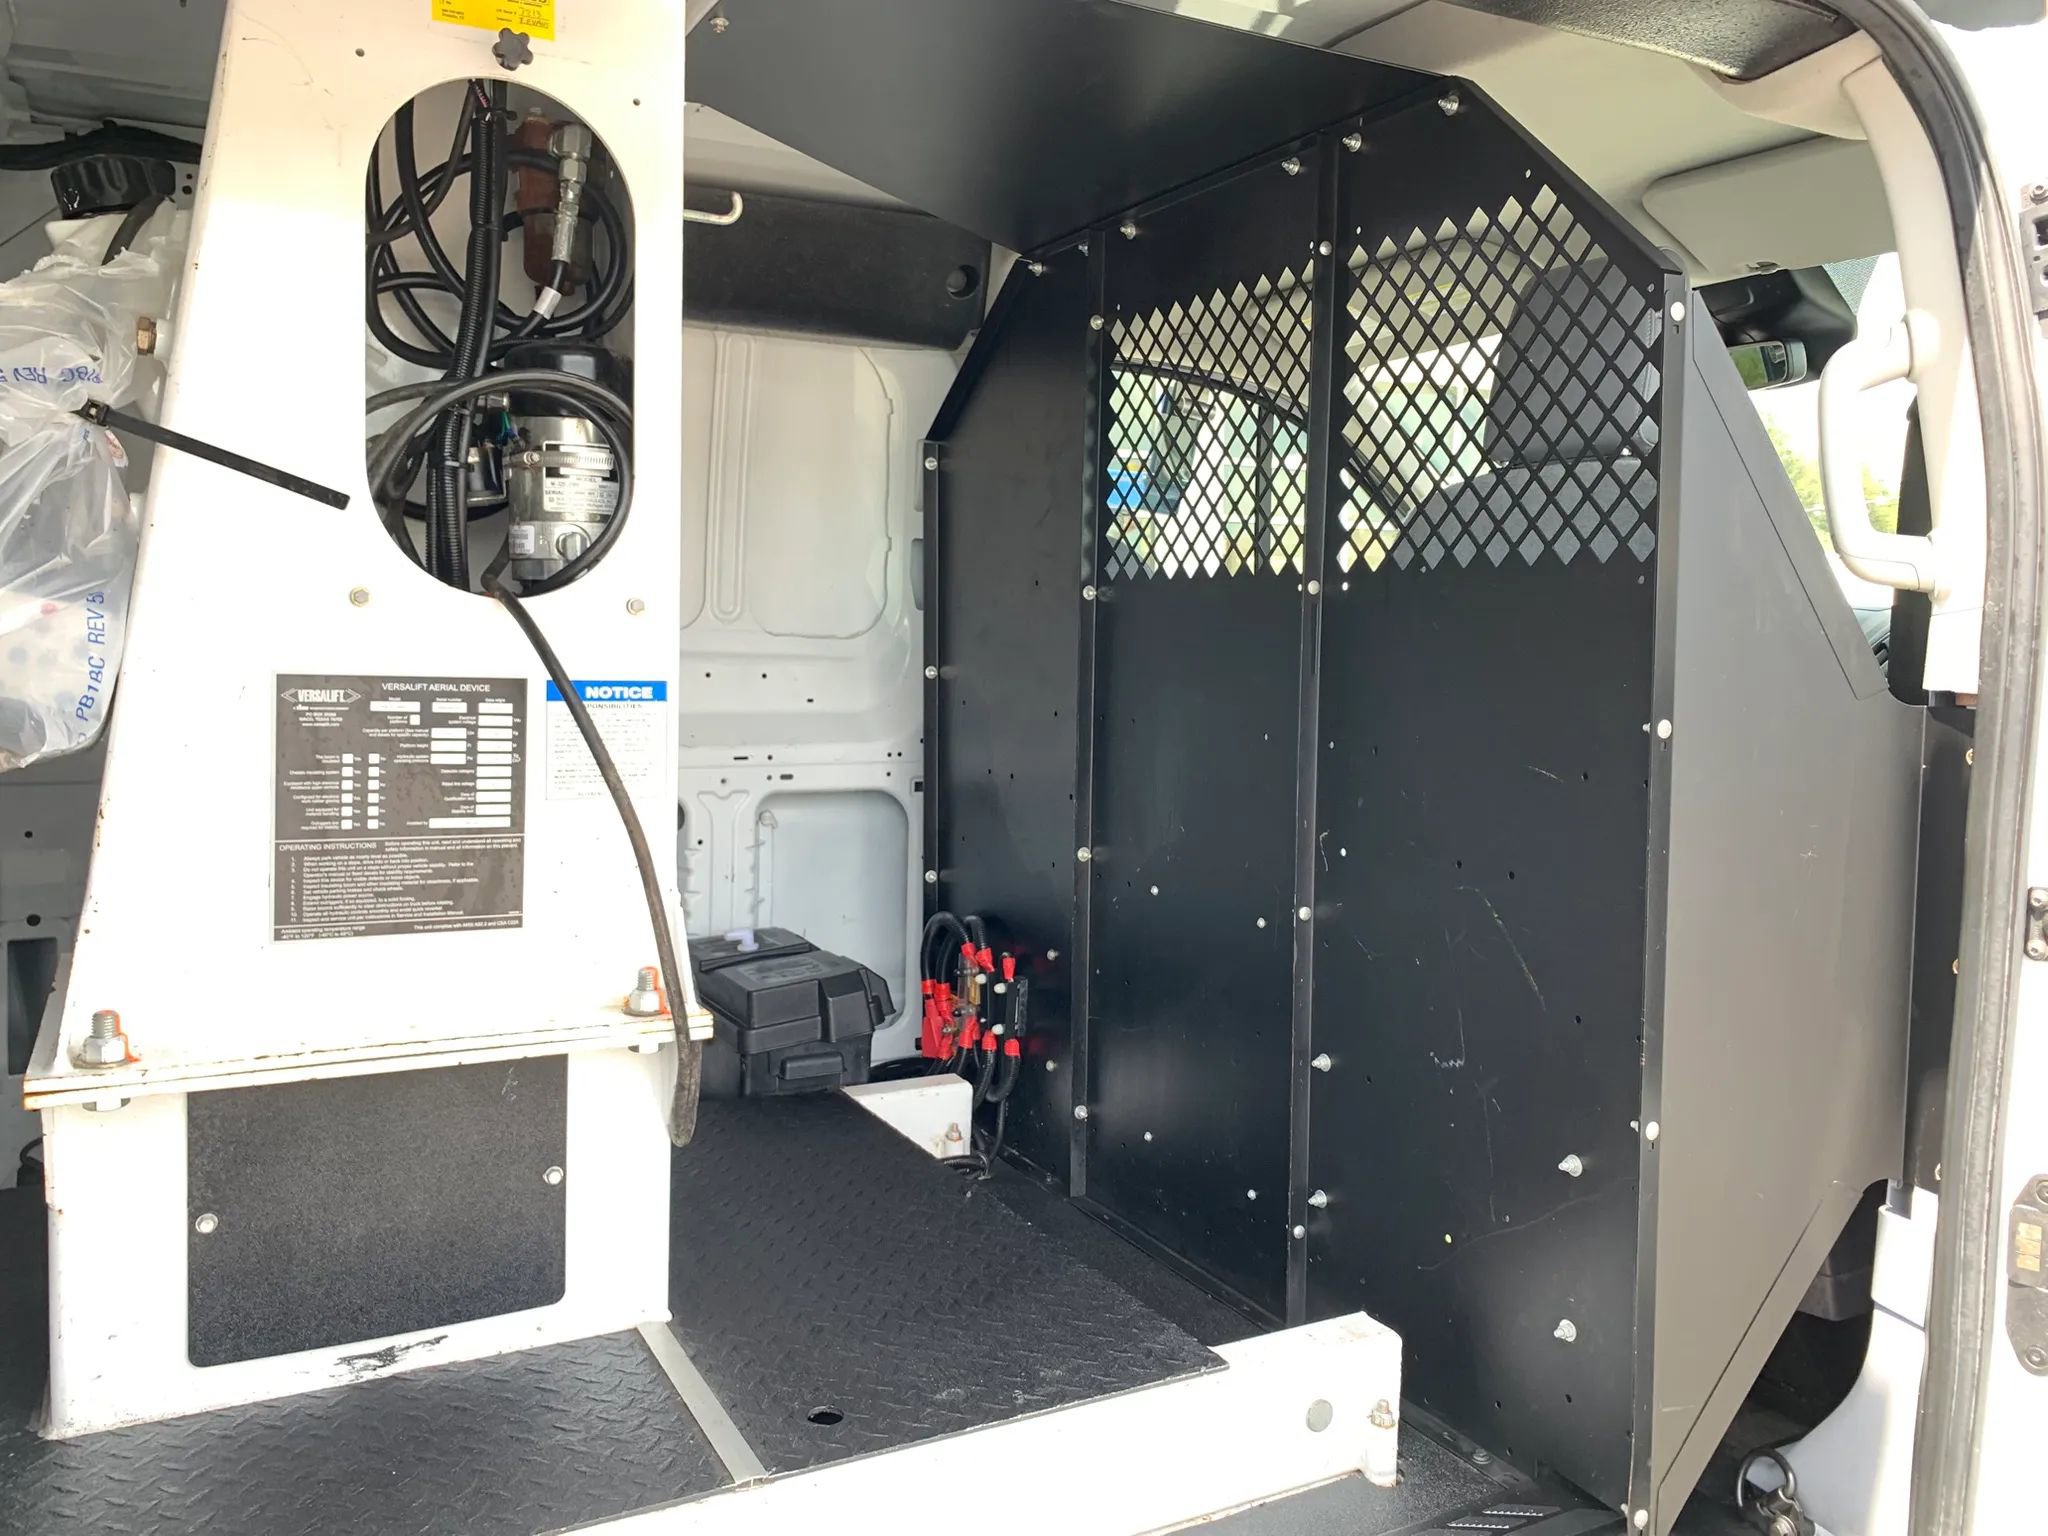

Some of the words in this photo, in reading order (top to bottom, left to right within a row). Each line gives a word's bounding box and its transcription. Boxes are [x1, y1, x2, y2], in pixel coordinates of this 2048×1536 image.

[86, 591, 105, 605] 5
[86, 608, 106, 645] REV
[382, 683, 428, 691] VERSALIFT
[460, 684, 490, 692] DEVICE
[585, 686, 653, 699] NOTICE
[297, 689, 345, 703] VERSALIFT
[280, 843, 322, 851] OPERATING
[323, 842, 376, 850] INSTRUCTIONS
